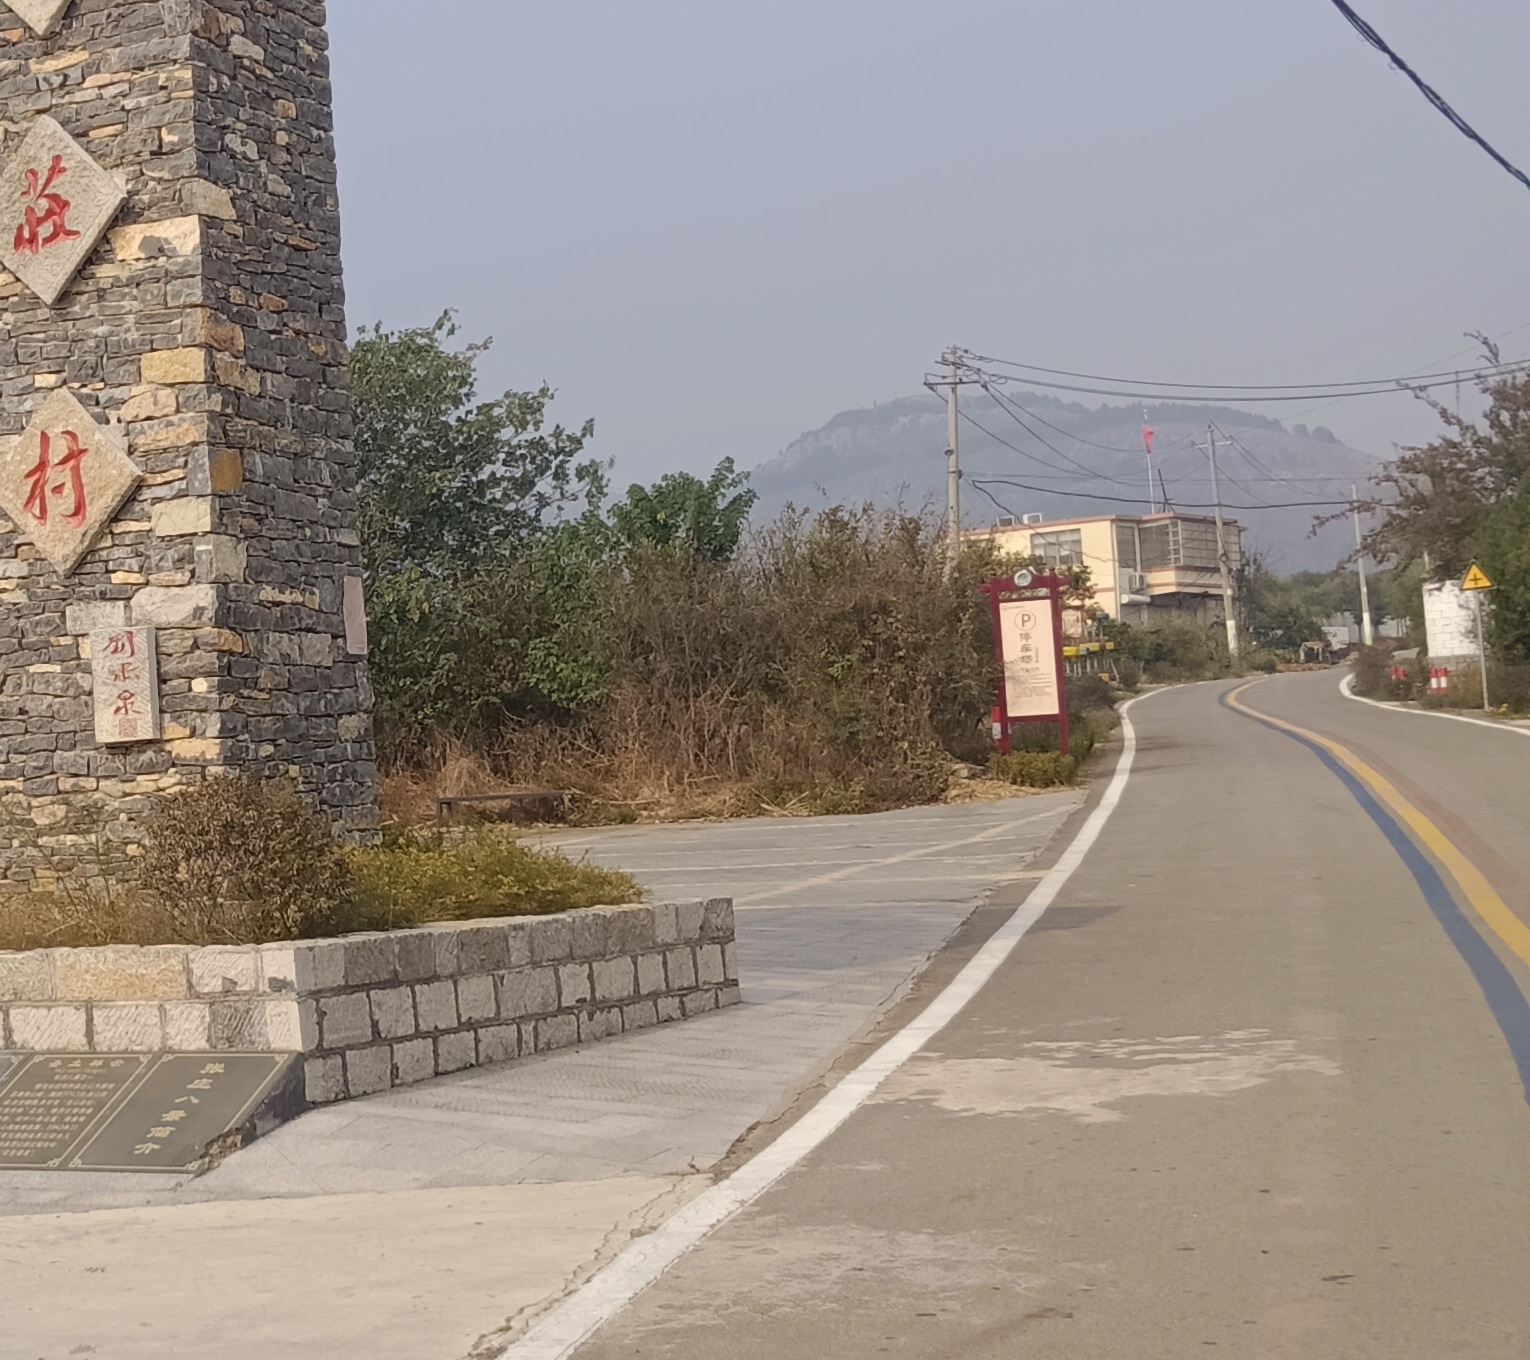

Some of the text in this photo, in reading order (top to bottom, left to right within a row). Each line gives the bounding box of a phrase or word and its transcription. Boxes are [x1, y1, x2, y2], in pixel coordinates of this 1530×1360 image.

[1021, 613, 1032, 628] P
[134, 1062, 226, 1155] 张庄八景简介
